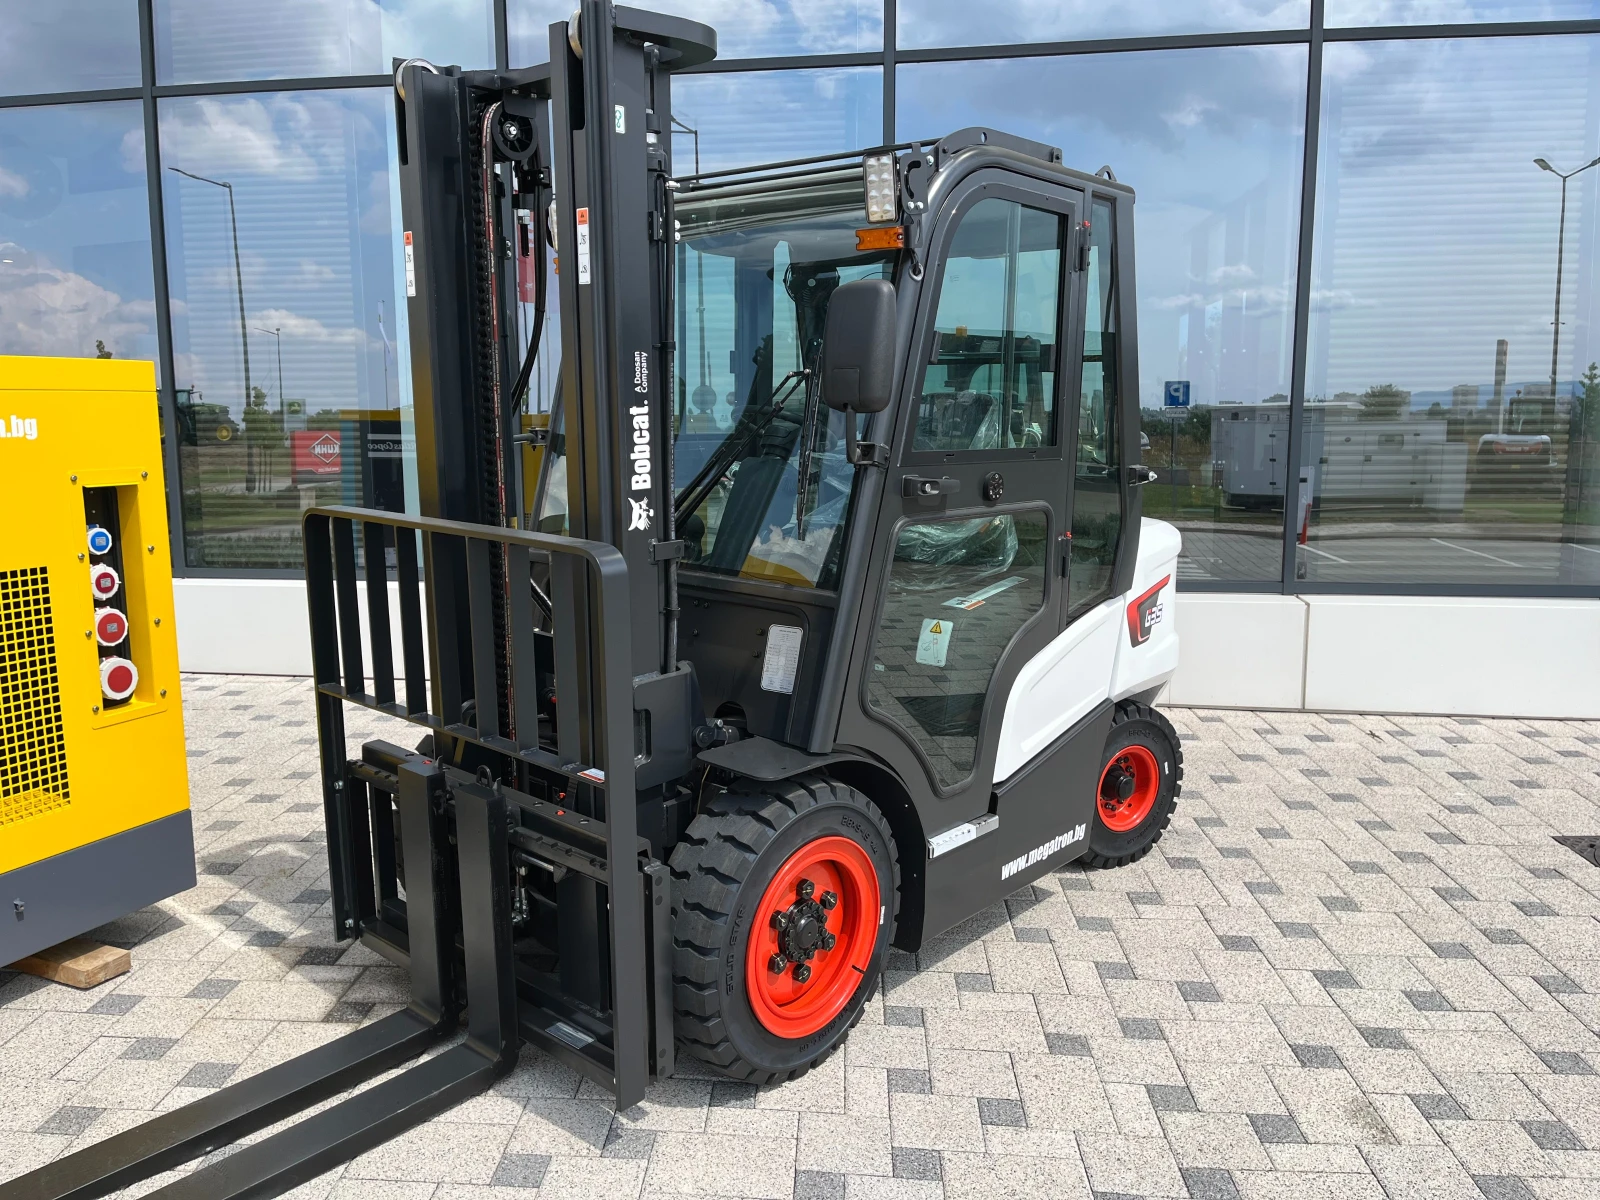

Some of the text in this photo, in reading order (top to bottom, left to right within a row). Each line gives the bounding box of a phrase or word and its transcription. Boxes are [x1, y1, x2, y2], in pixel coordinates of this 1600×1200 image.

[634, 385, 641, 393] A
[640, 351, 649, 393] Company
[1001, 822, 1087, 881] www.megatron.bg
